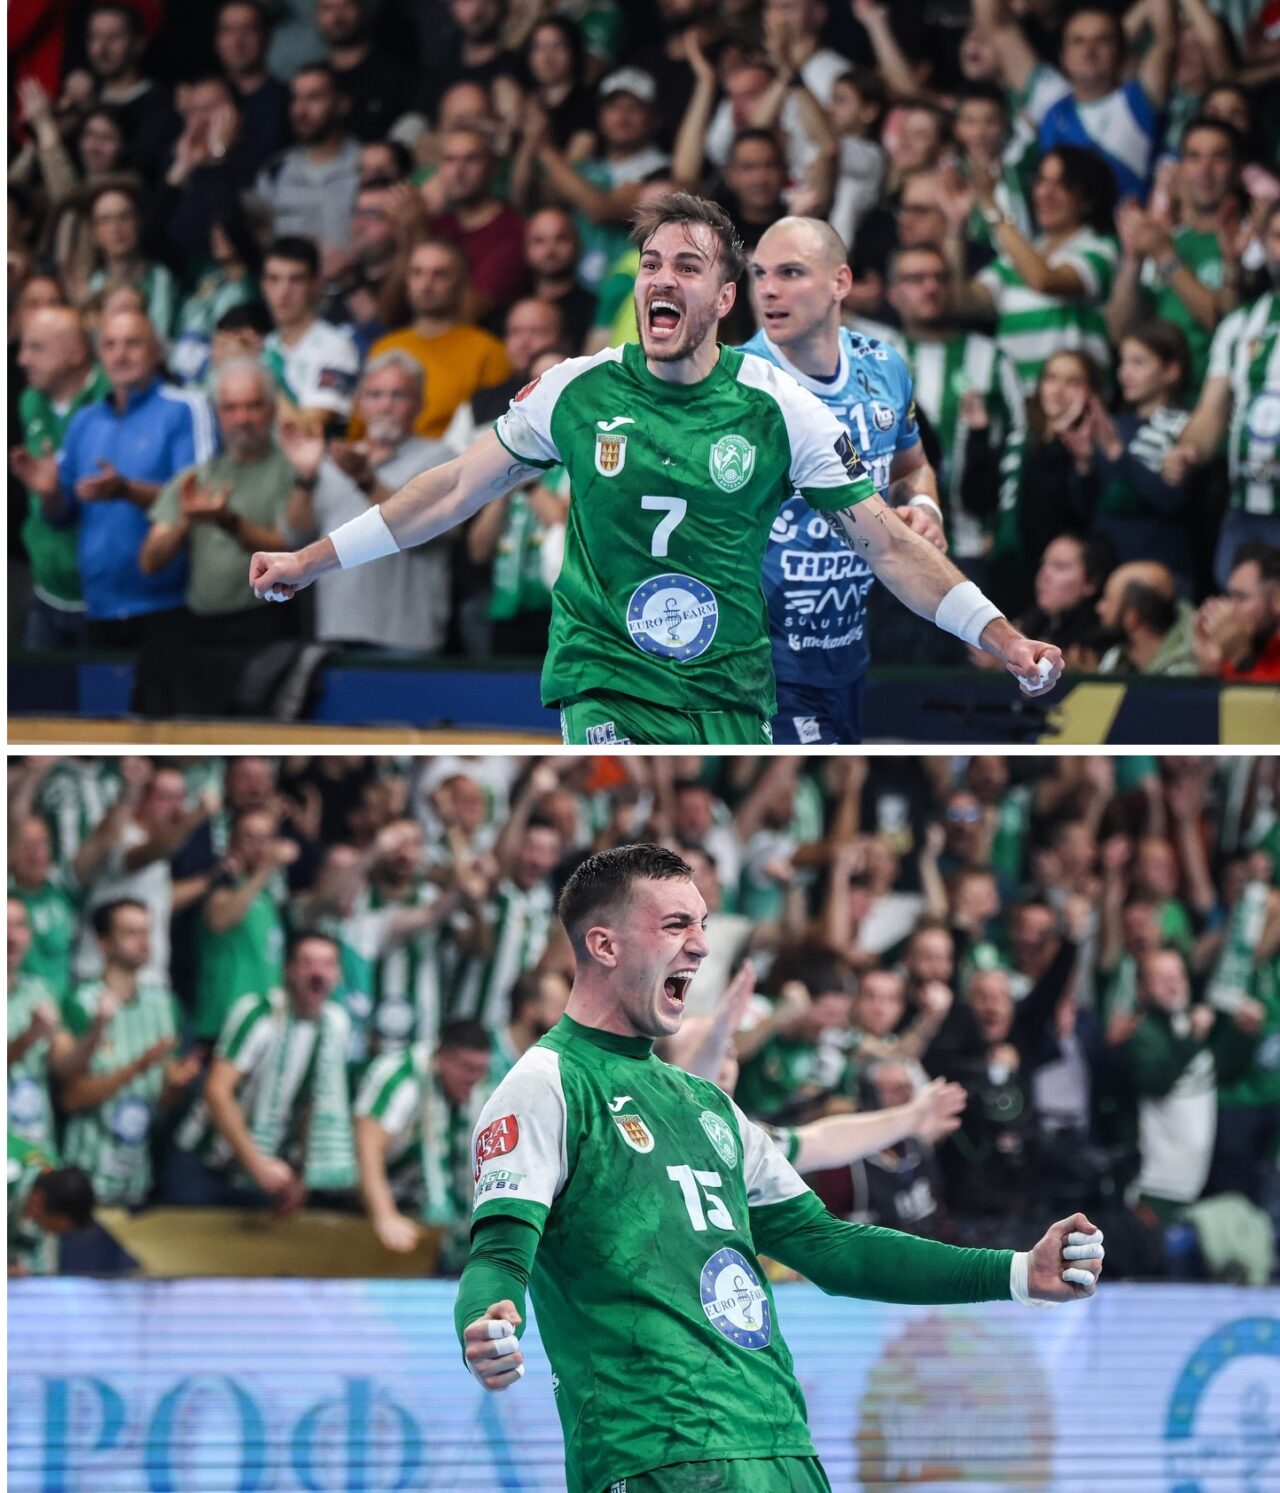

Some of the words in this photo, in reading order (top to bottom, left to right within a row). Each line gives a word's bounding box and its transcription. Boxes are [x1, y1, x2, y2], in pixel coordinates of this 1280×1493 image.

[640, 495, 688, 558] 7
[629, 617, 664, 632] EURO
[683, 602, 717, 621] FARM
[586, 722, 617, 745] ICE
[666, 1165, 736, 1231] 15
[705, 1297, 736, 1317] EURO
